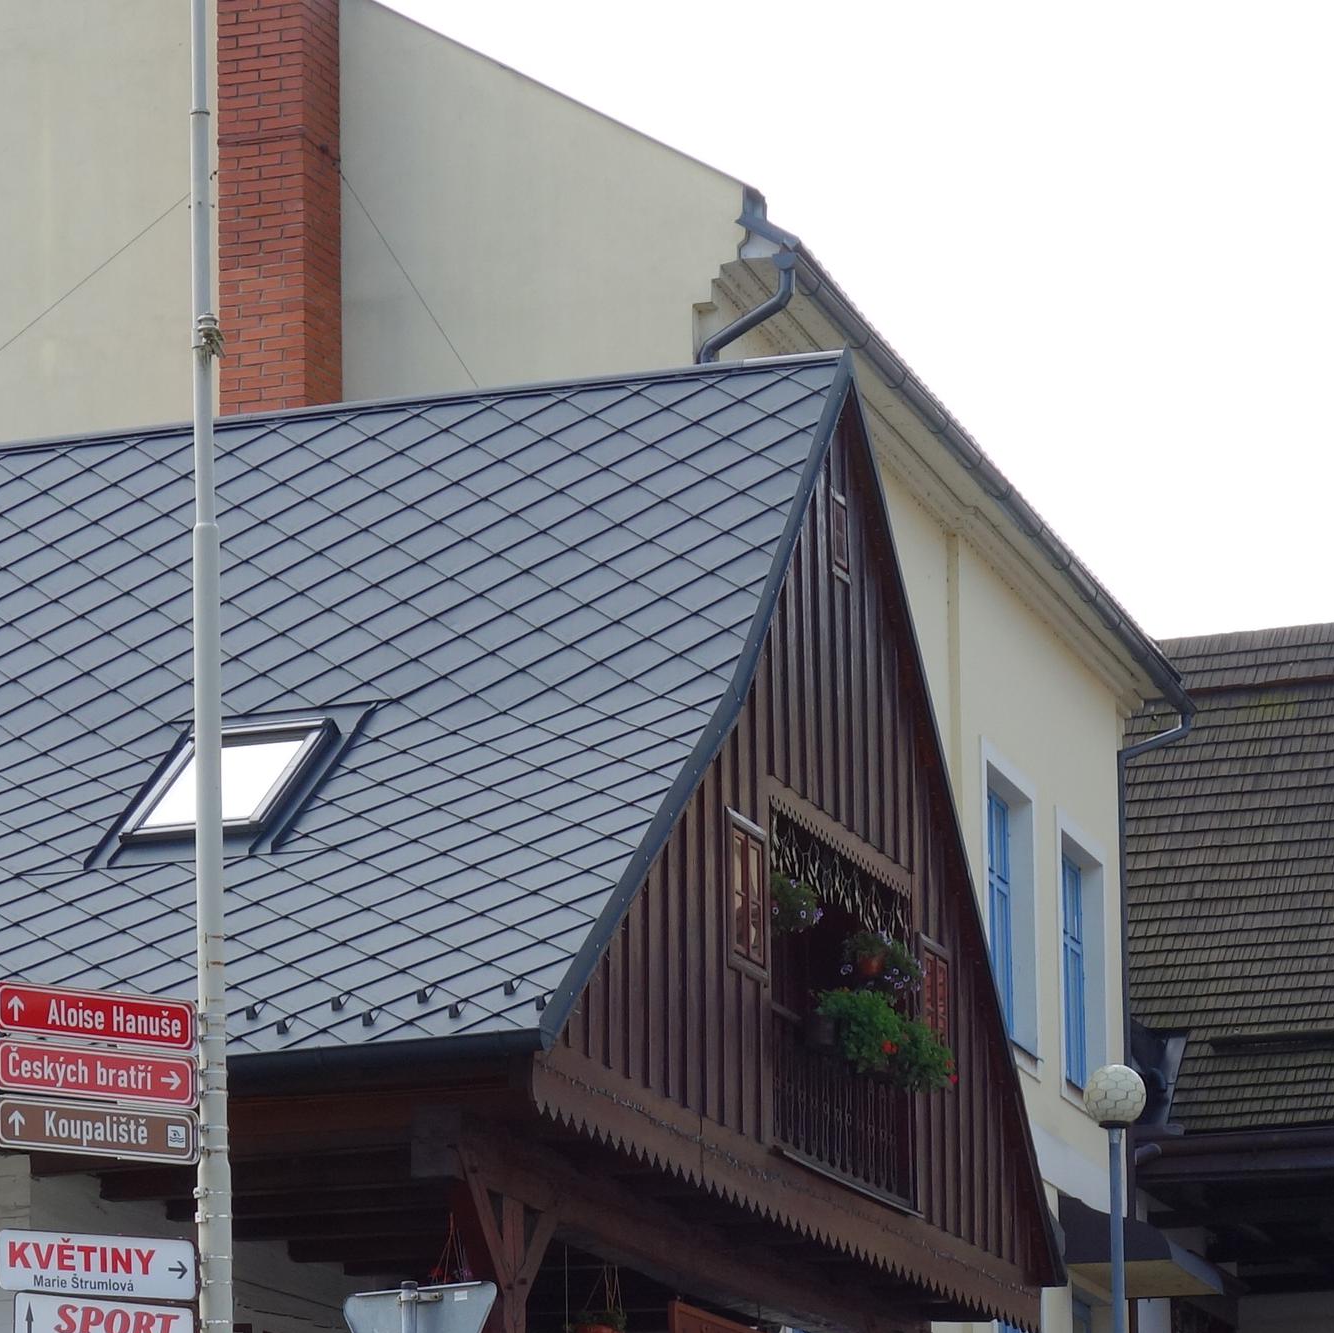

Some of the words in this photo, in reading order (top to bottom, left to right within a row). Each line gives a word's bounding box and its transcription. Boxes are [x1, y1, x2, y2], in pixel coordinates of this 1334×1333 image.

[47, 998, 105, 1030] Aloise
[112, 1006, 182, 1038] Hanuše
[8, 1047, 88, 1087] Českých
[96, 1060, 153, 1090] bratří
[44, 1110, 148, 1146] Koupaliště
[8, 1238, 155, 1275] KVĚTINY
[33, 1274, 67, 1289] Marie
[71, 1273, 134, 1292] Štrumlová
